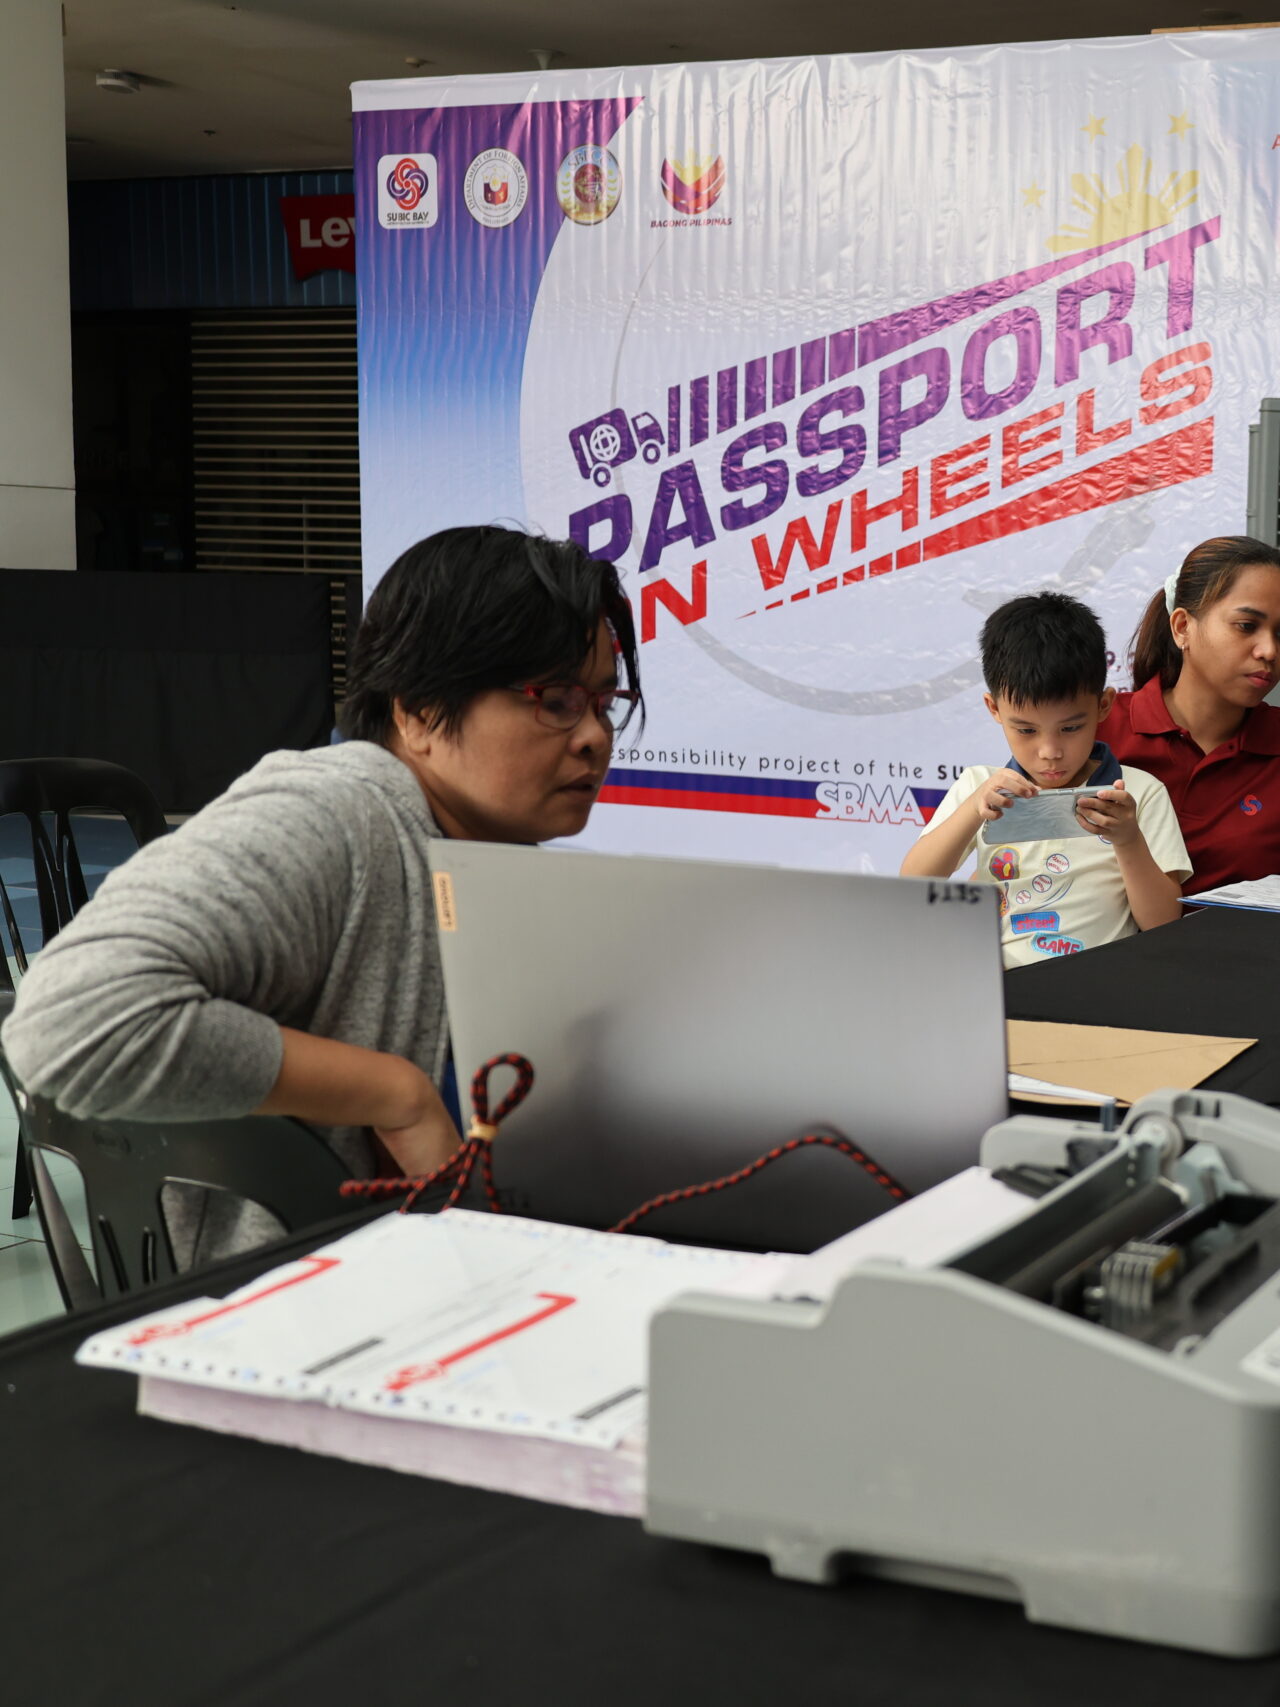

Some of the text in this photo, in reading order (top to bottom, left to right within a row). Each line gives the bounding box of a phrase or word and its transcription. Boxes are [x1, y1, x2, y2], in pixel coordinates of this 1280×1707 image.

[386, 211, 429, 222] SUBIC BAY
[650, 217, 733, 229] BAGONG PILIPINAS
[569, 215, 1221, 574] PASSPORT
[624, 340, 1213, 645] N WHEELS
[611, 747, 747, 771] sponsibility
[758, 755, 841, 775] project
[854, 758, 877, 775] of
[888, 761, 923, 779] the
[815, 780, 928, 827] SBMA
[1016, 915, 1057, 931] street
[1036, 936, 1081, 955] GAME
